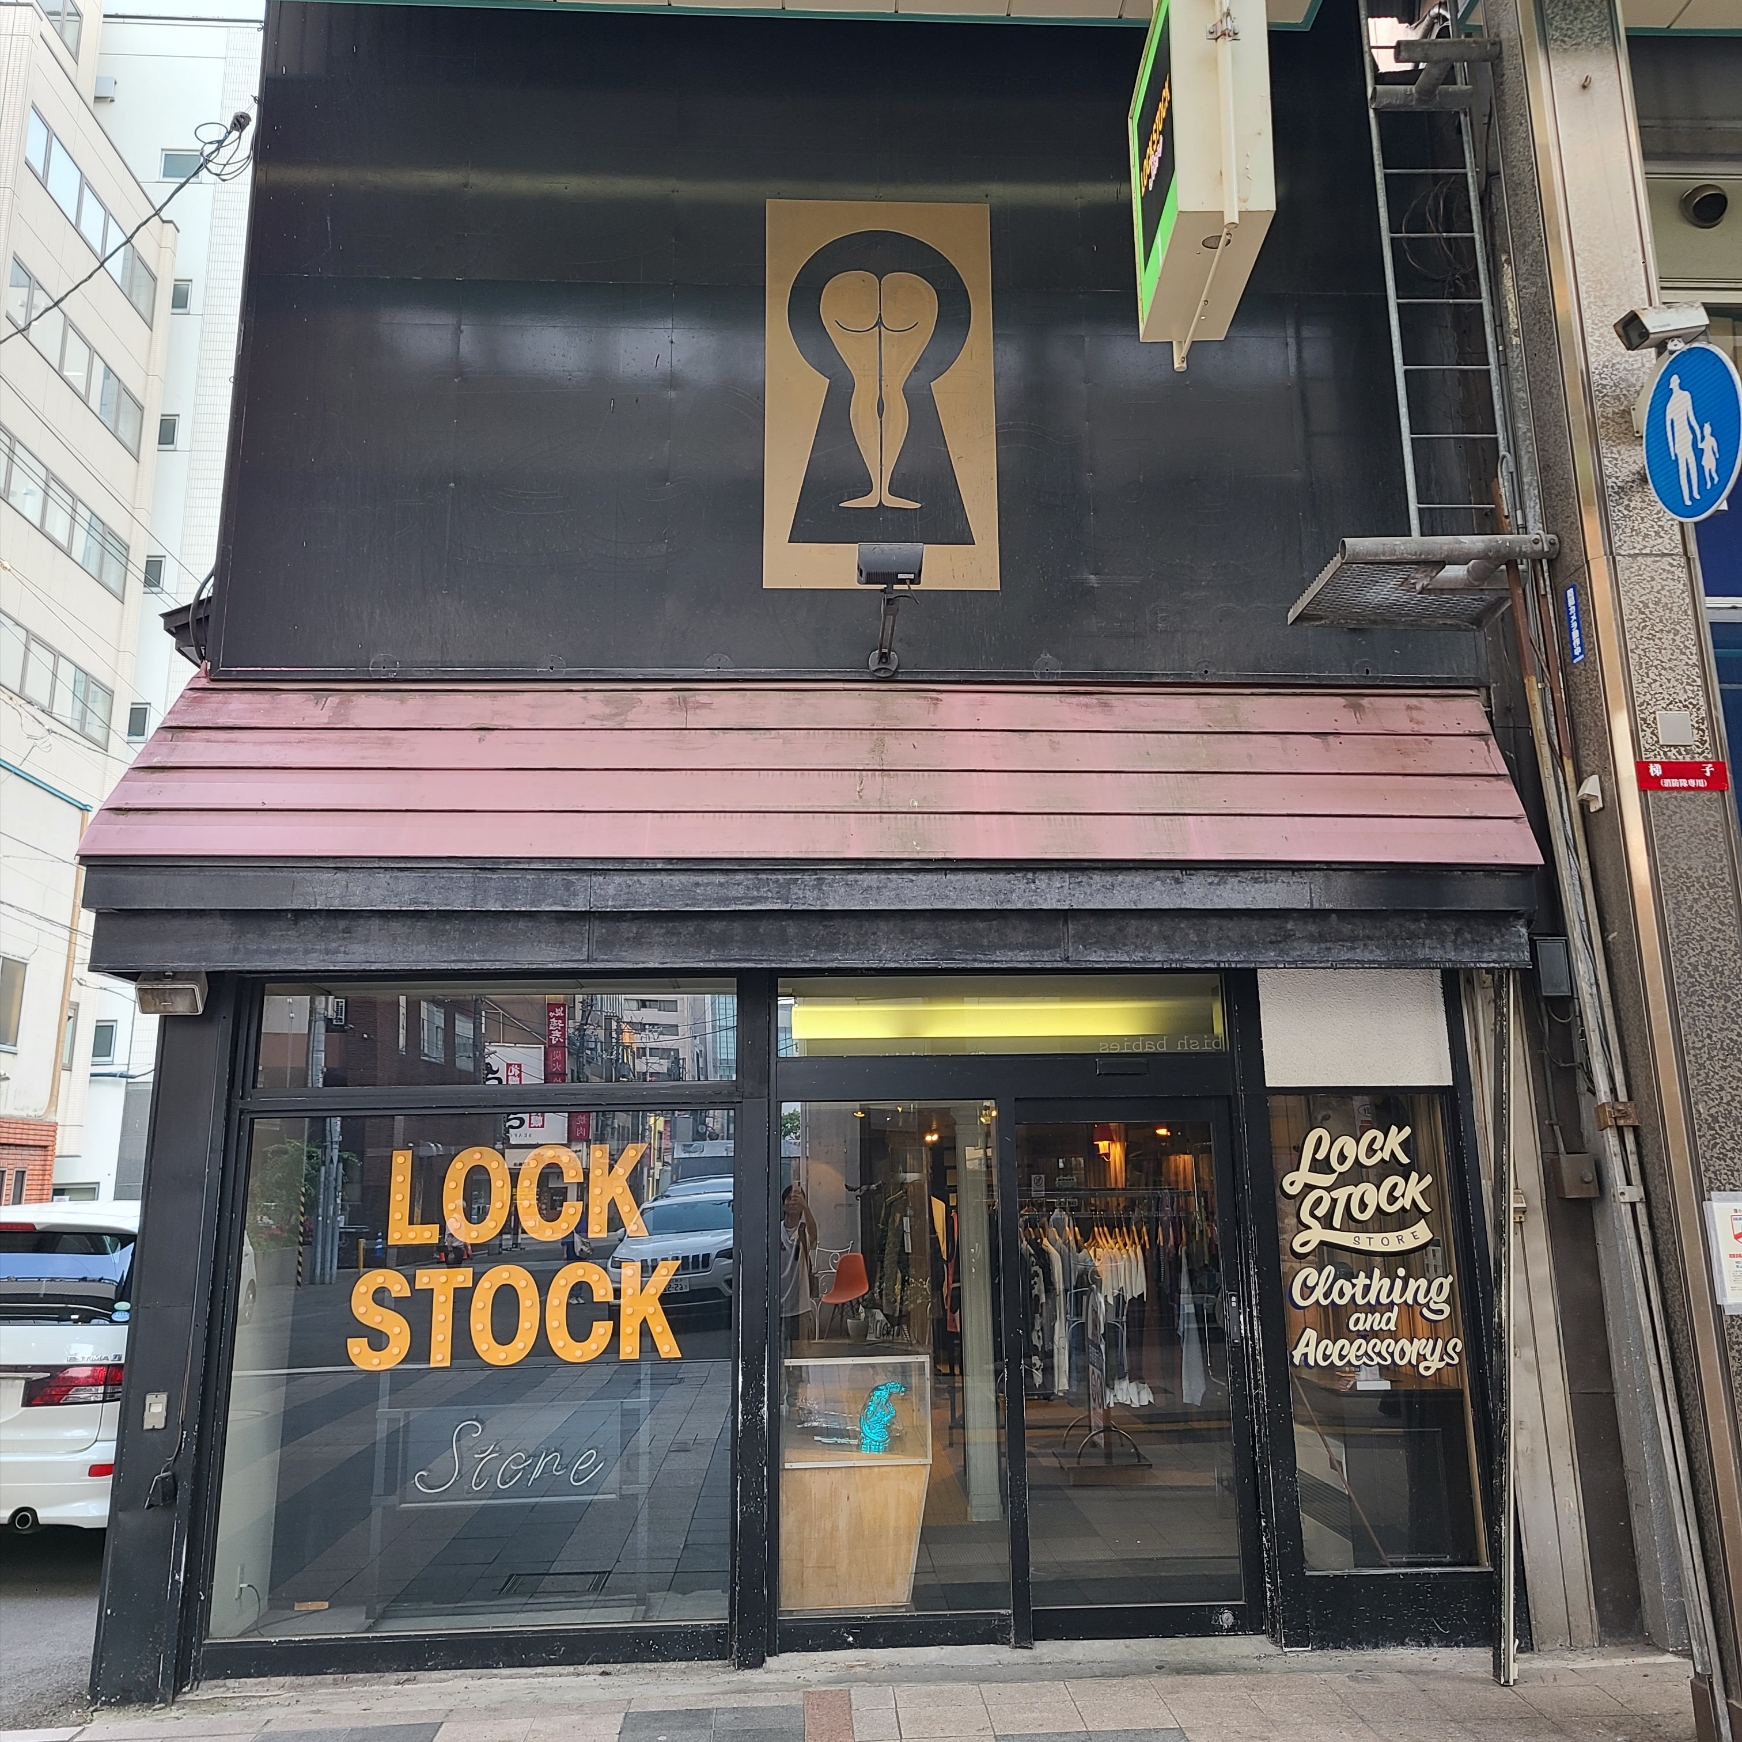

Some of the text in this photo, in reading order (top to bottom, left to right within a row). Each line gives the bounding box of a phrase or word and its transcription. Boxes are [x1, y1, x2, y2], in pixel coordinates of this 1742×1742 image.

[1282, 1124, 1412, 1195] LOCK
[388, 1143, 649, 1245] LOCK
[1292, 1171, 1433, 1253] STOCK
[1352, 1230, 1420, 1247] STORE
[347, 1260, 682, 1371] STOCK
[1291, 1264, 1454, 1321] Clothing
[1348, 1304, 1399, 1332] and
[1291, 1327, 1463, 1377] Accessorys
